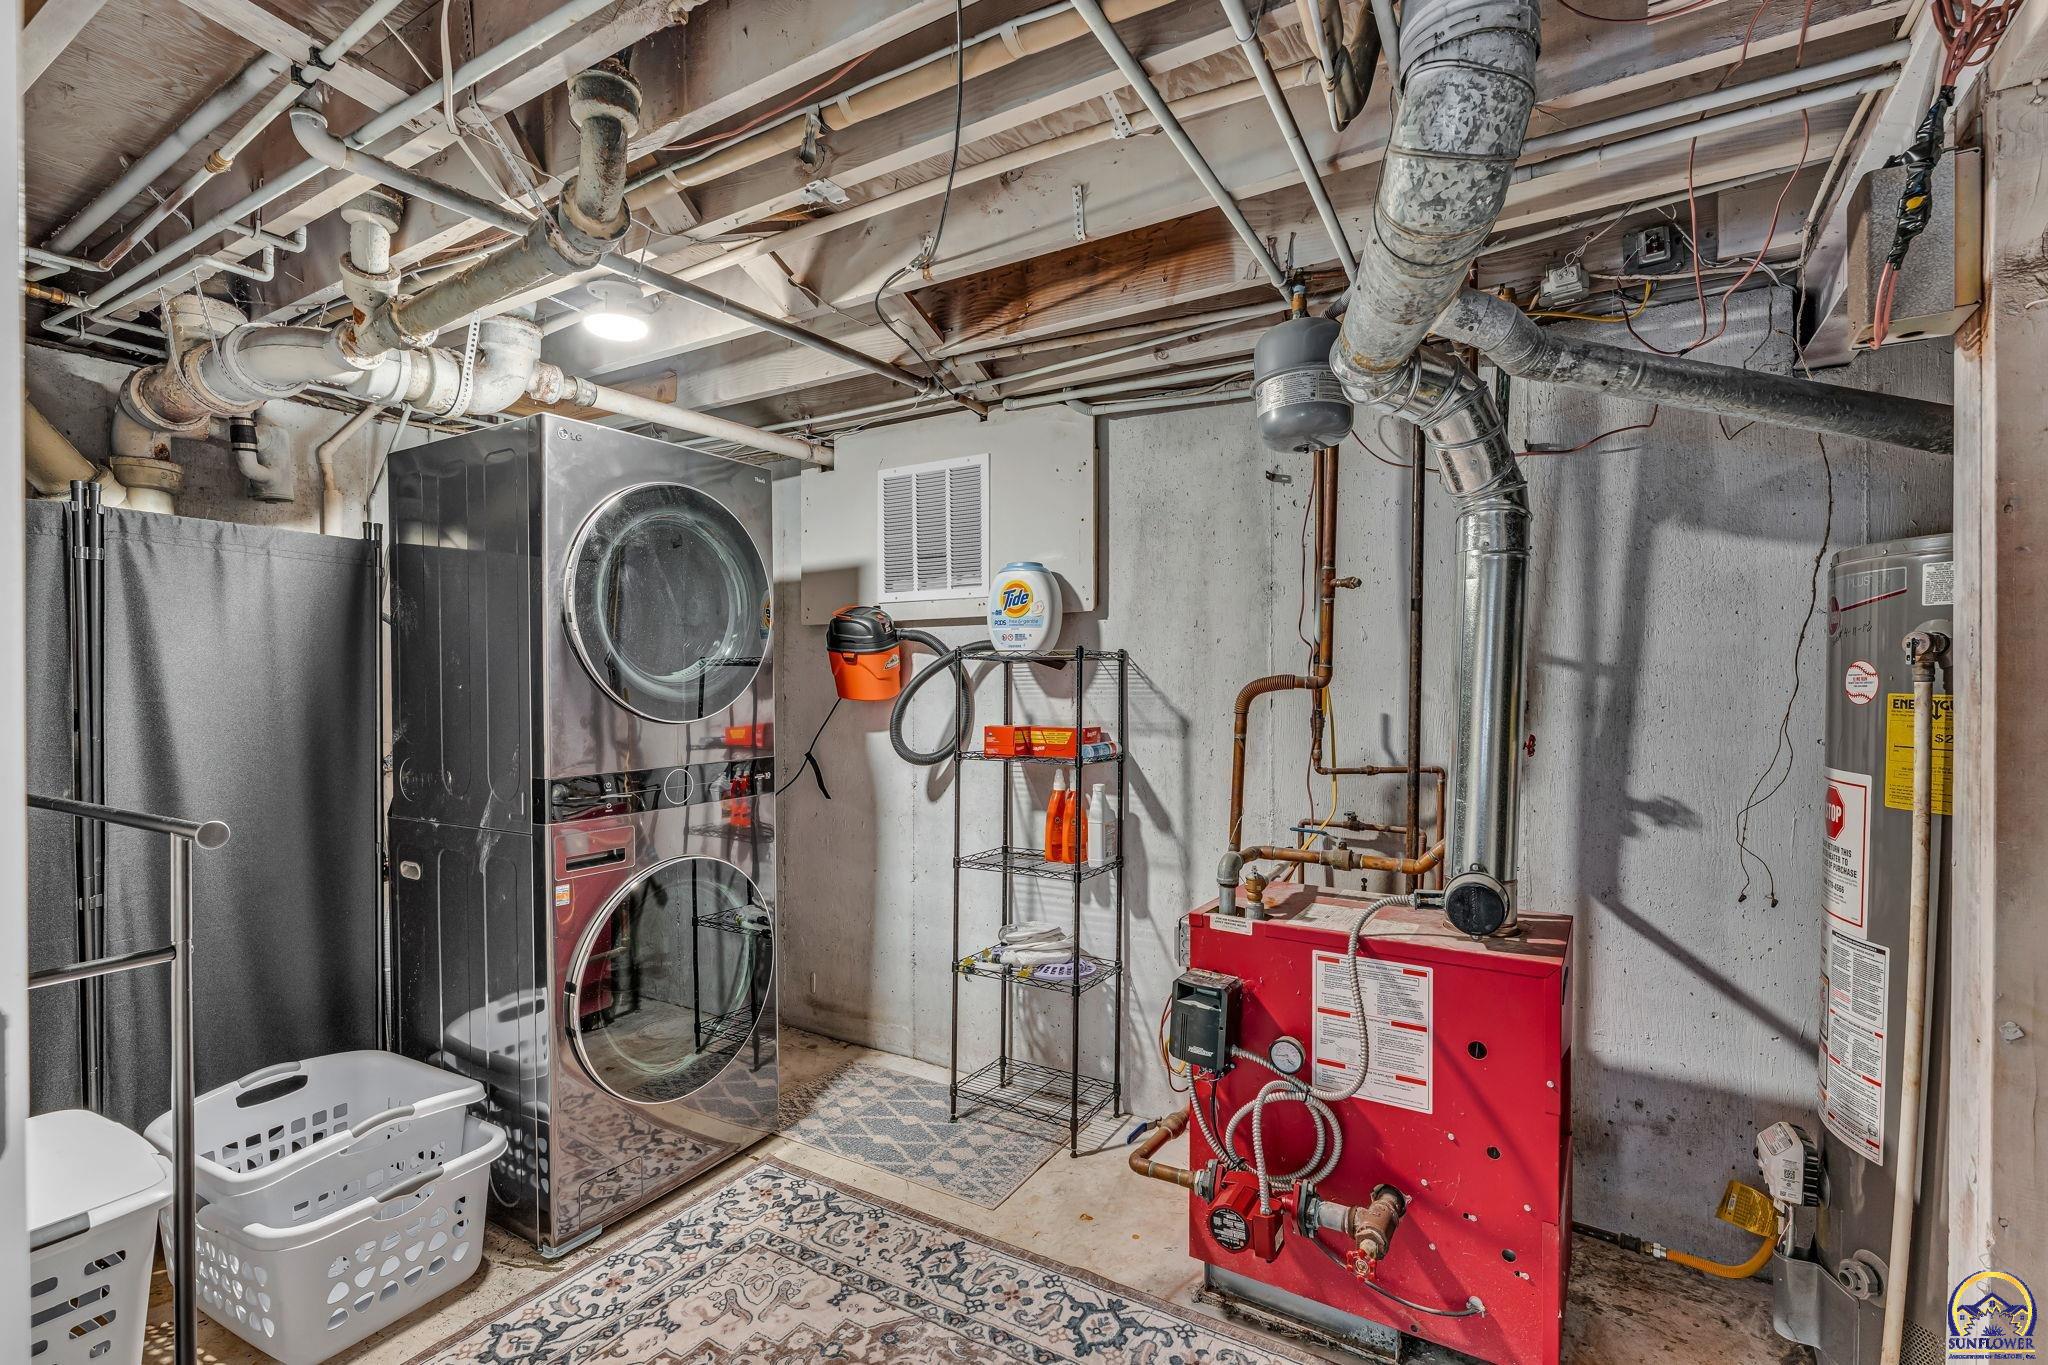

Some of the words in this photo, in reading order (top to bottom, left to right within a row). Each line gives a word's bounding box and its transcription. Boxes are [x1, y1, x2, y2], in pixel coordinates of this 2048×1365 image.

[570, 432, 583, 441] LG
[1003, 587, 1029, 611] Tide
[1841, 847, 1852, 858] THIS
[1842, 857, 1849, 866] TO
[1833, 862, 1857, 879] PURCHASE
